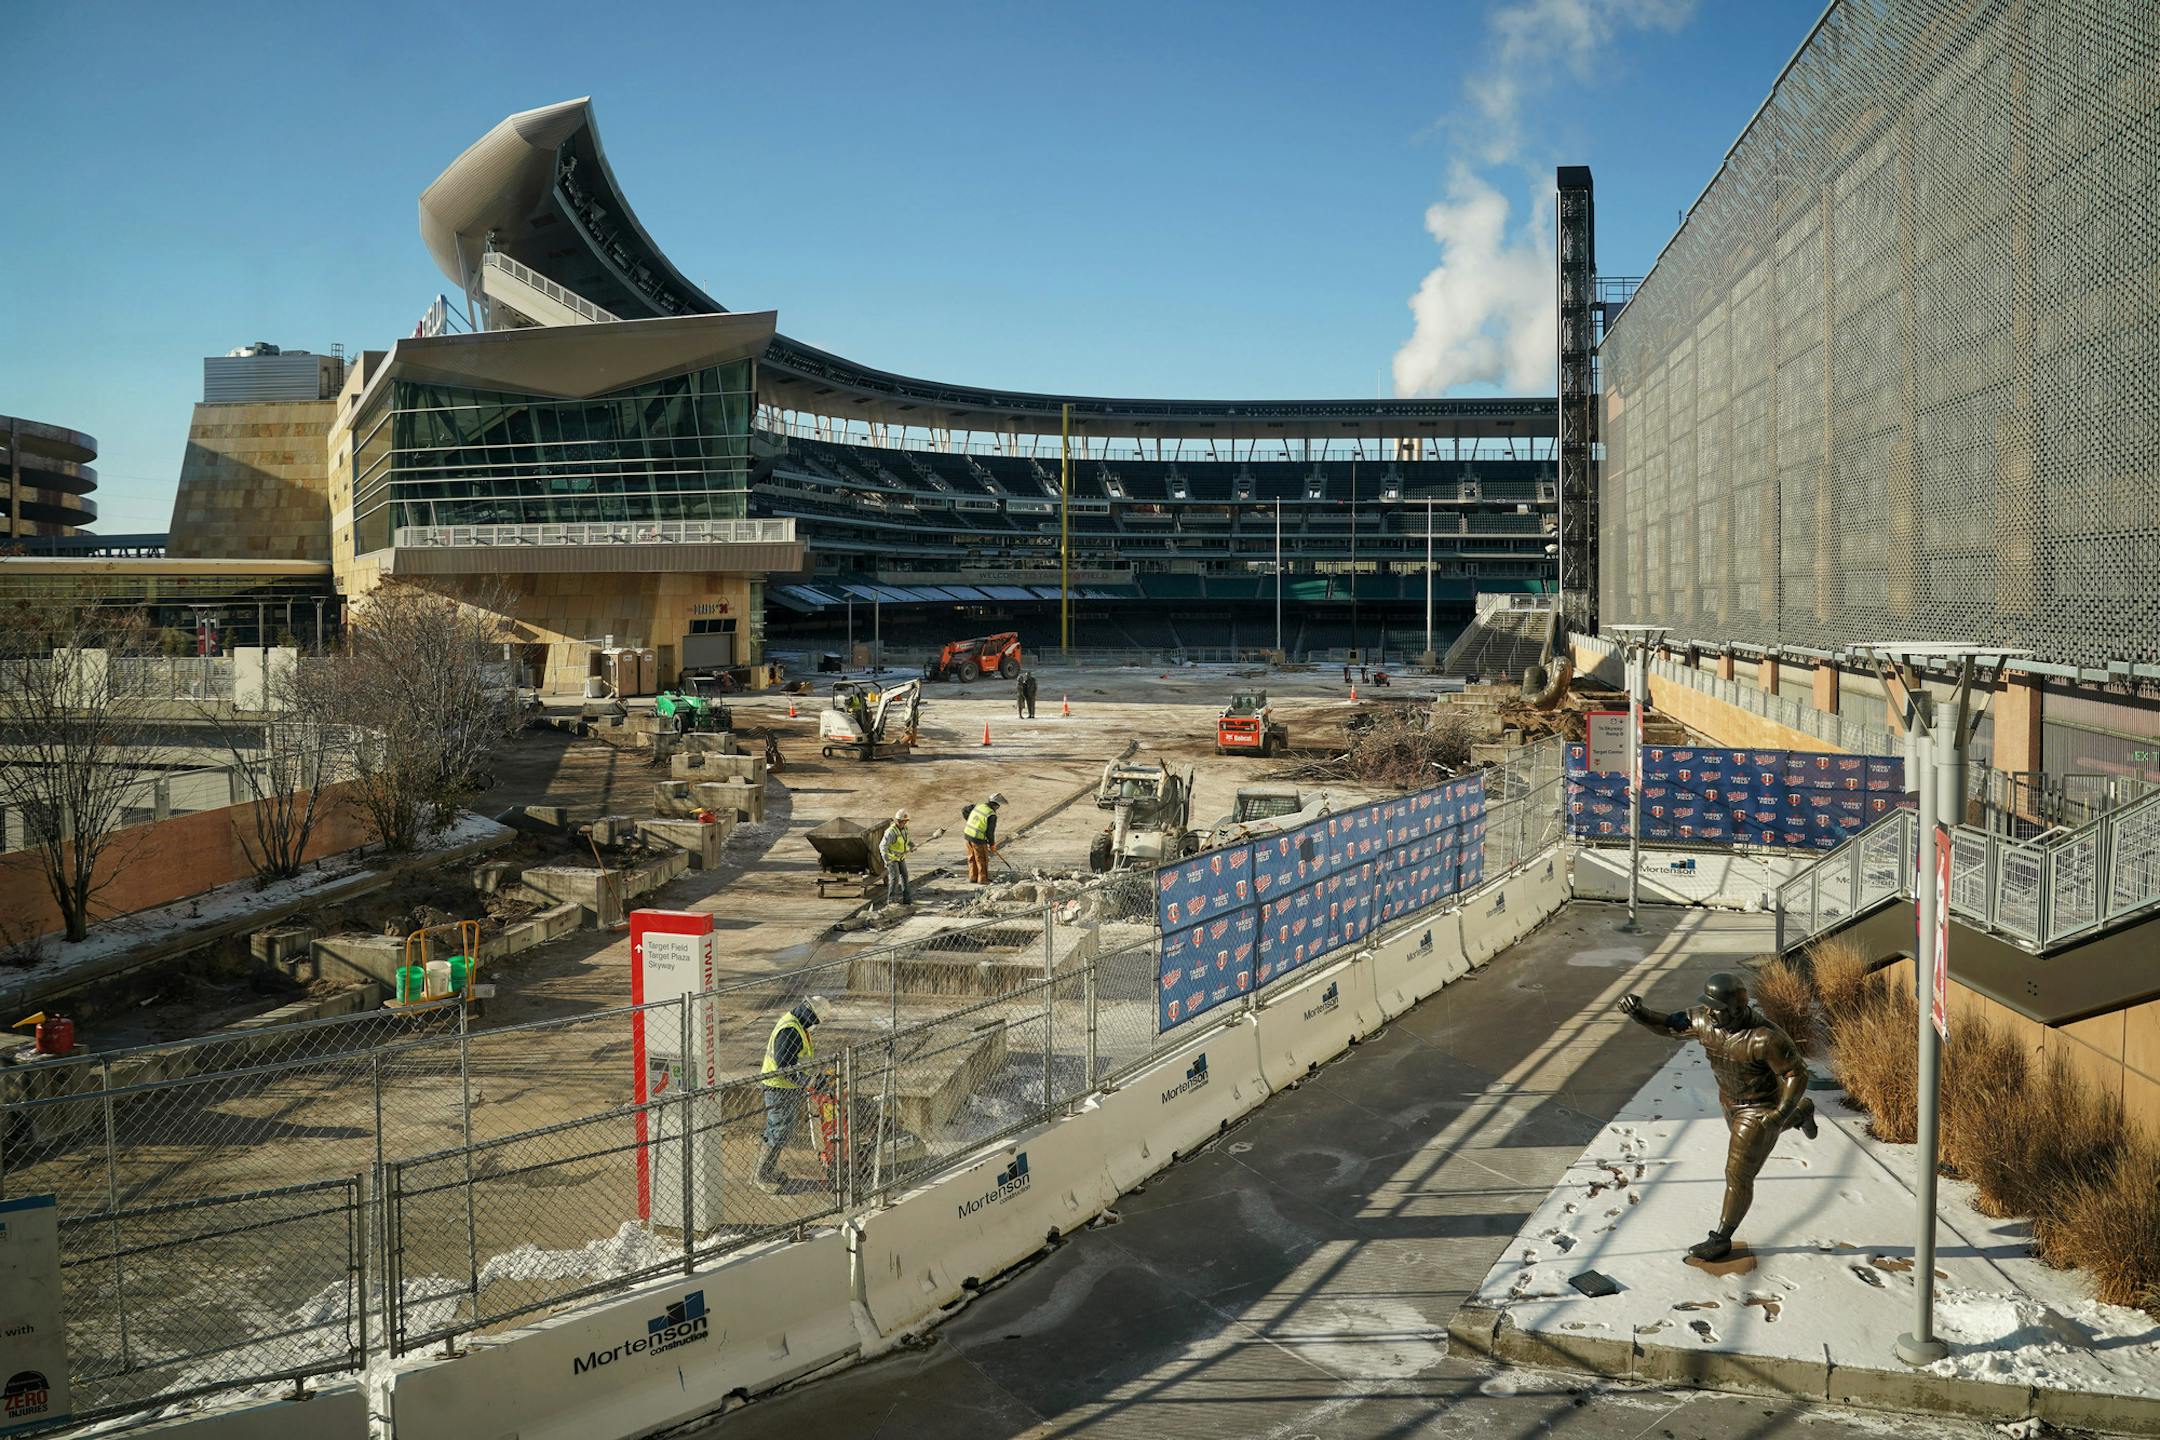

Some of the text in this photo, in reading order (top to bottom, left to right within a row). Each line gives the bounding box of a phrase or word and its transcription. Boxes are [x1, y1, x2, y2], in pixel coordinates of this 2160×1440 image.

[1640, 865, 1696, 875] Mortenson
[648, 941, 688, 952] Target Field
[648, 950, 691, 962] Target Plaza
[648, 960, 676, 971] Skyway
[1304, 996, 1339, 1022] Mortenson
[1161, 1070, 1209, 1104] Mortenson
[958, 1174, 1030, 1219] Mortenson
[5, 1324, 34, 1336] with
[573, 1316, 707, 1375] Mortenson
[650, 1330, 709, 1356] construction
[4, 1389, 48, 1411] ZERO
[8, 1404, 48, 1418] INJURIES
